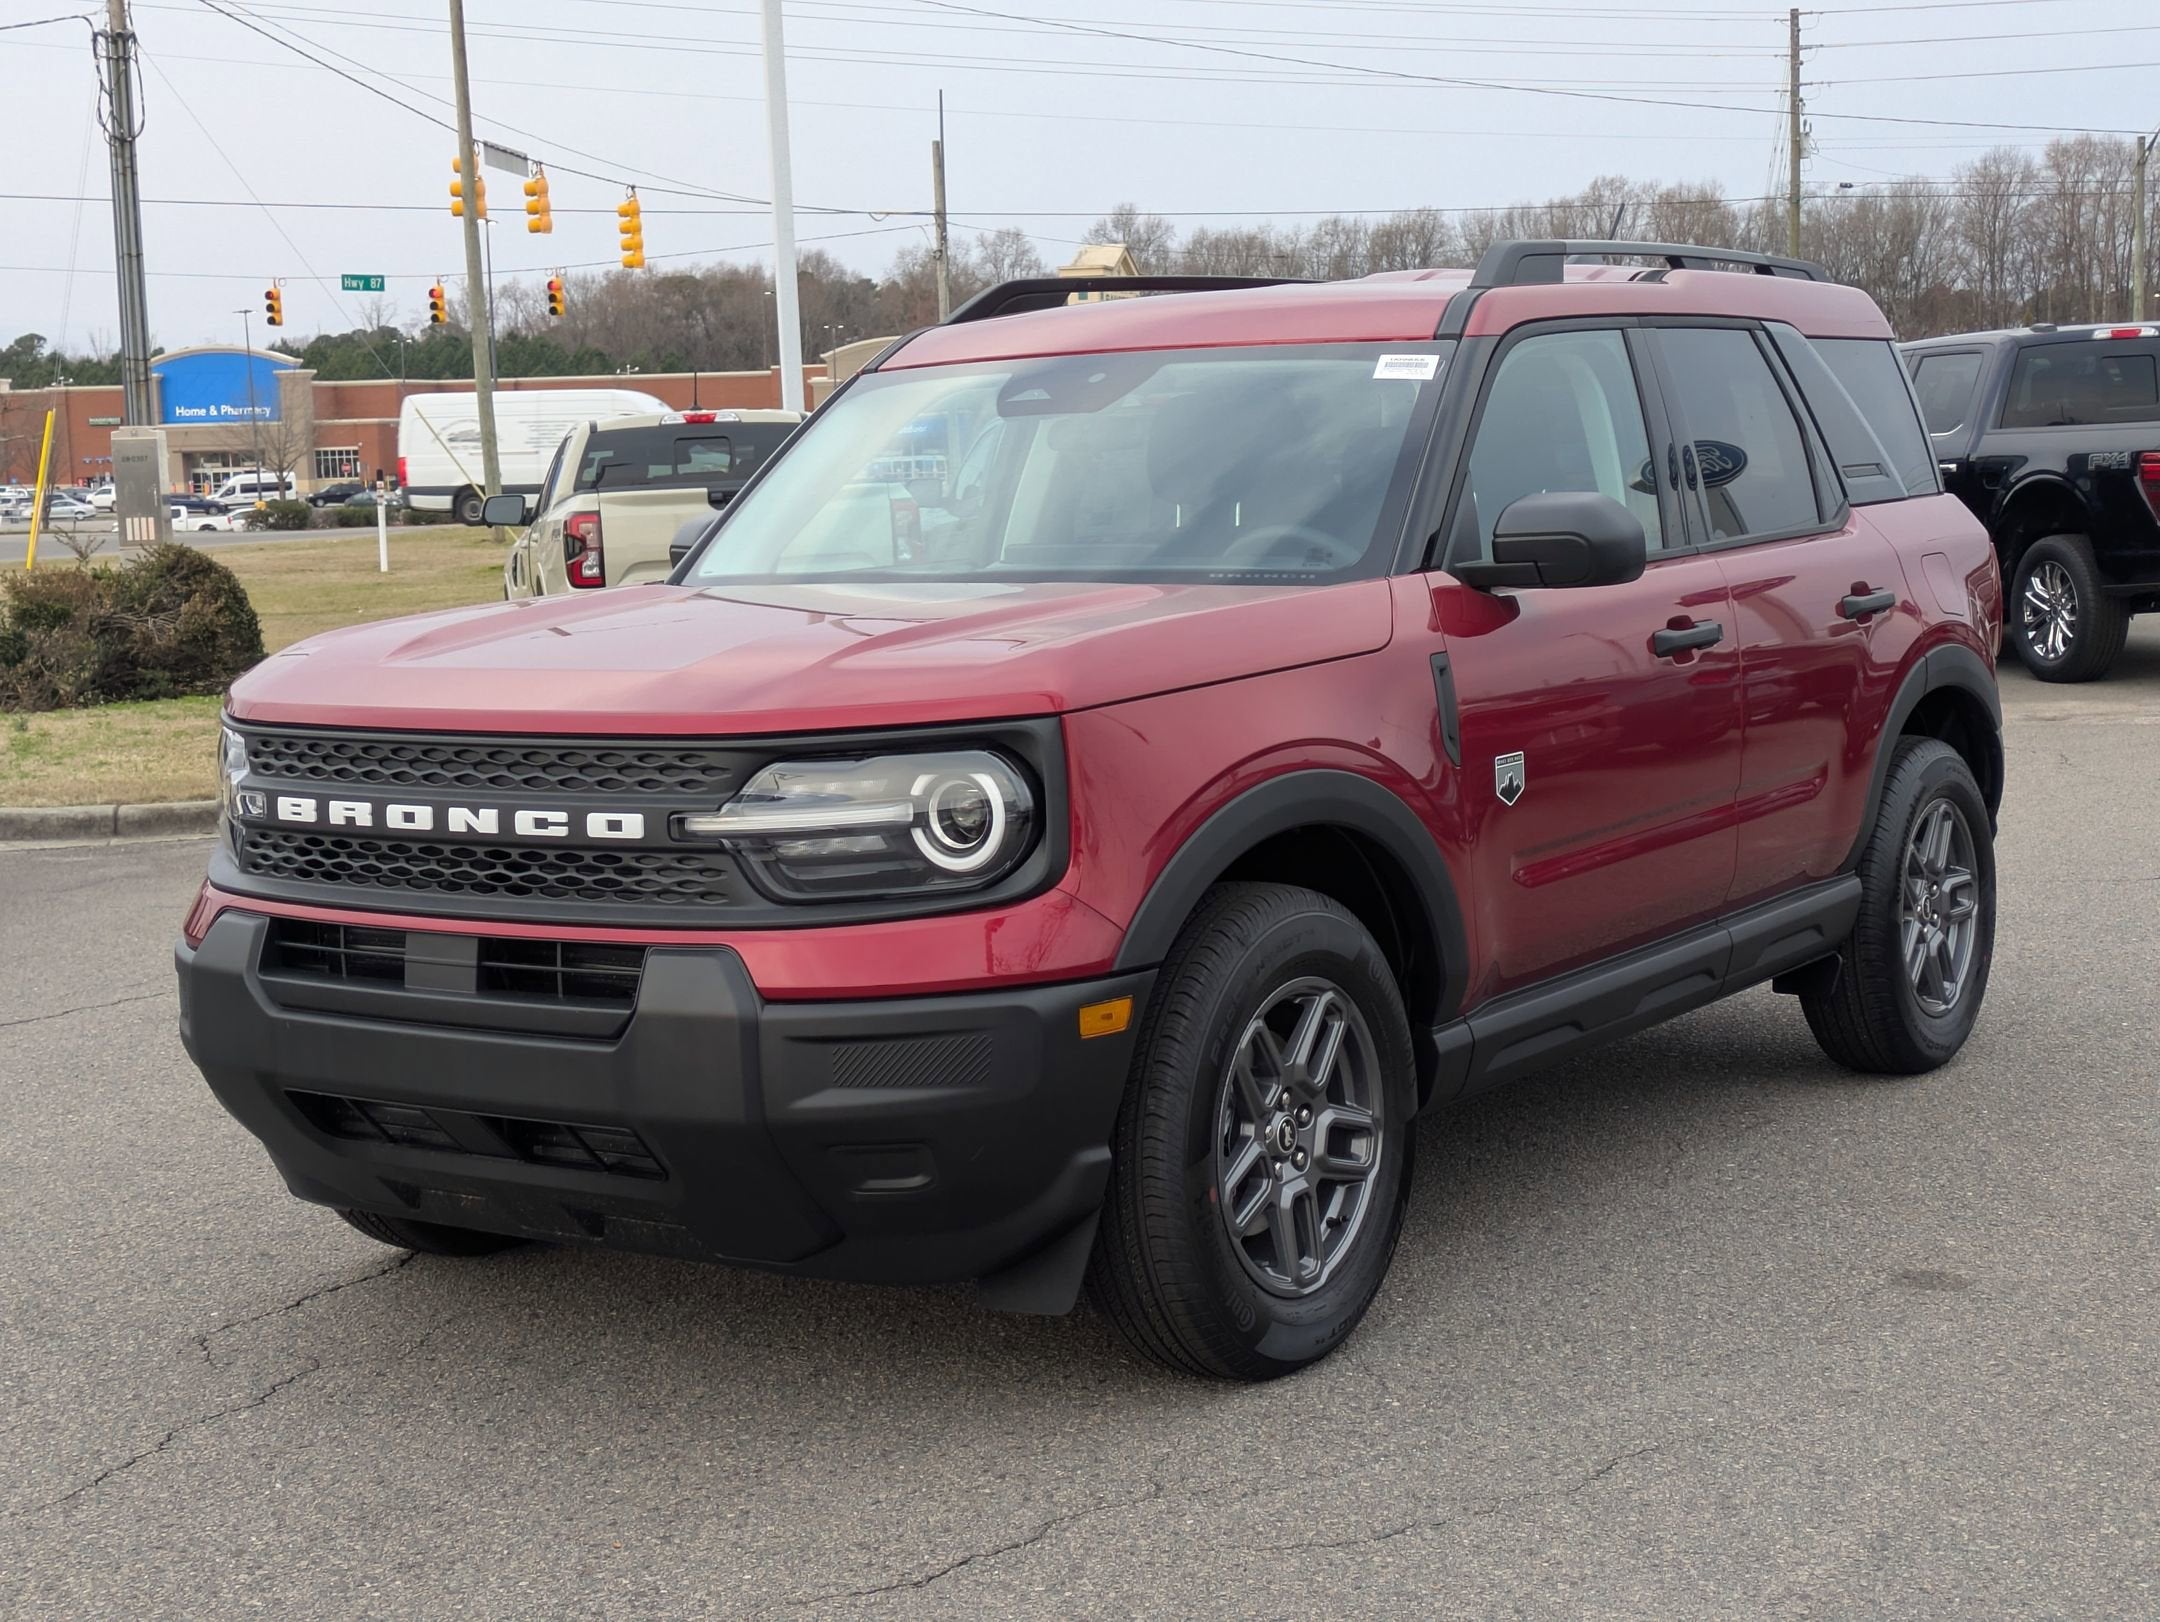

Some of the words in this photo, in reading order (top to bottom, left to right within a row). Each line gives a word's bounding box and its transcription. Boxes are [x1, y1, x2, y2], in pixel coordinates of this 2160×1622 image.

[344, 277, 364, 290] Hwy
[370, 278, 382, 289] 87
[175, 406, 206, 416] Home
[209, 405, 217, 416] &
[220, 405, 271, 417] Pharmacy
[2088, 452, 2129, 470] FX4
[277, 796, 646, 840] BRONCO
